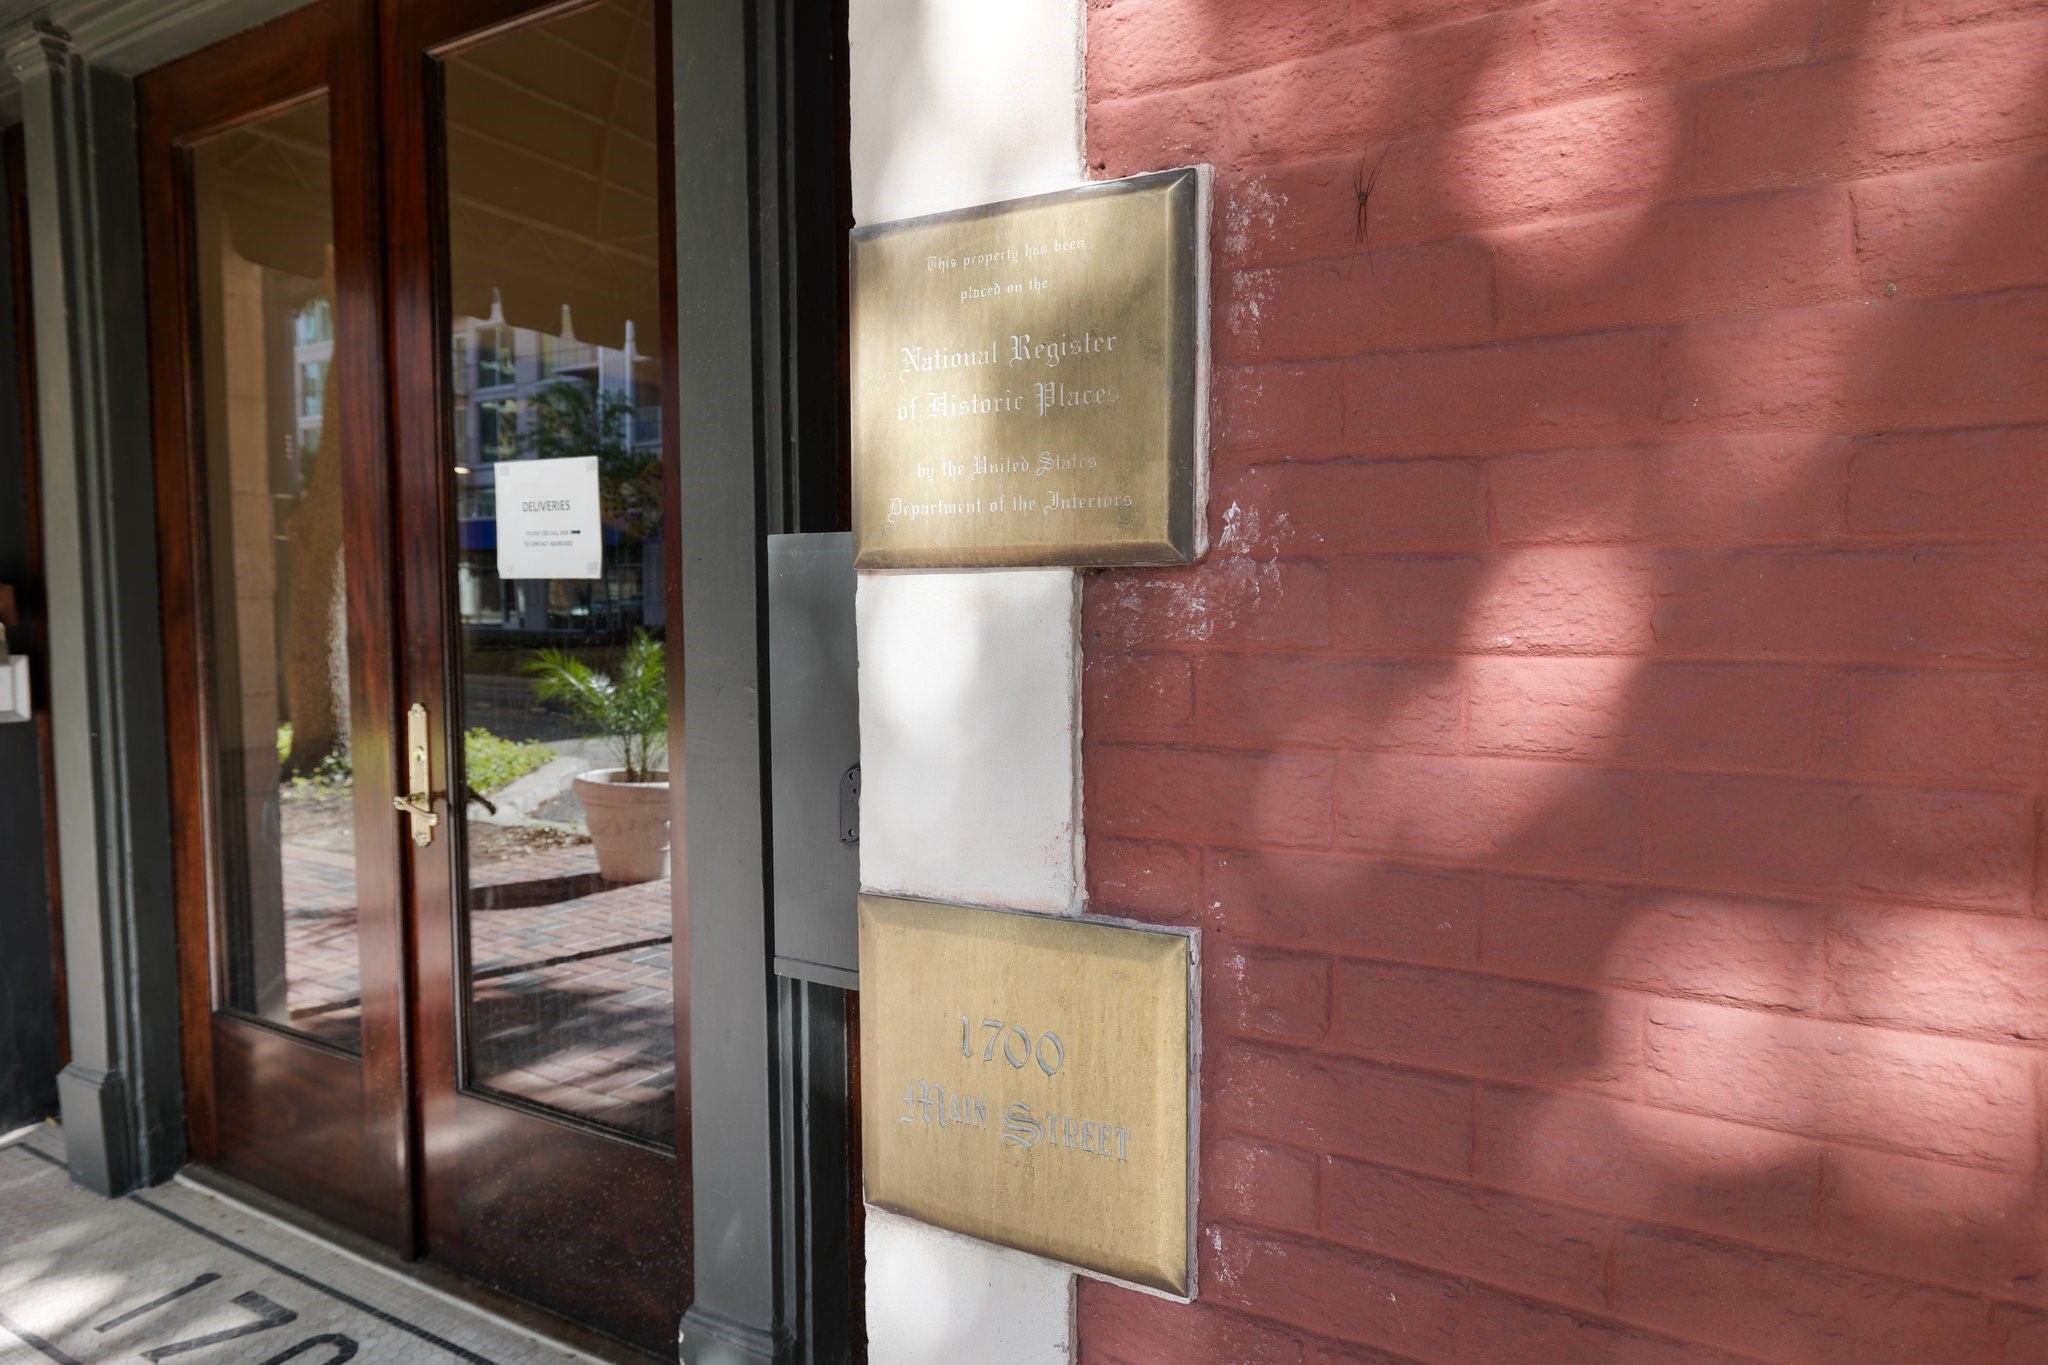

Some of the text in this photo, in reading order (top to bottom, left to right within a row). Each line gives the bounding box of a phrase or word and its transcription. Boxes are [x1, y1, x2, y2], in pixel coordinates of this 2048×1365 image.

[926, 238, 1085, 273] This property has been
[960, 277, 1049, 304] placed on the
[900, 332, 1118, 383] National Register
[897, 381, 1121, 421] of Historic Places
[917, 450, 1097, 485] by the United States
[522, 500, 571, 512] DELIVERIES
[888, 496, 982, 523] Department
[989, 495, 1005, 513] of
[1013, 495, 1036, 518] the
[960, 1015, 1065, 1077] 1700
